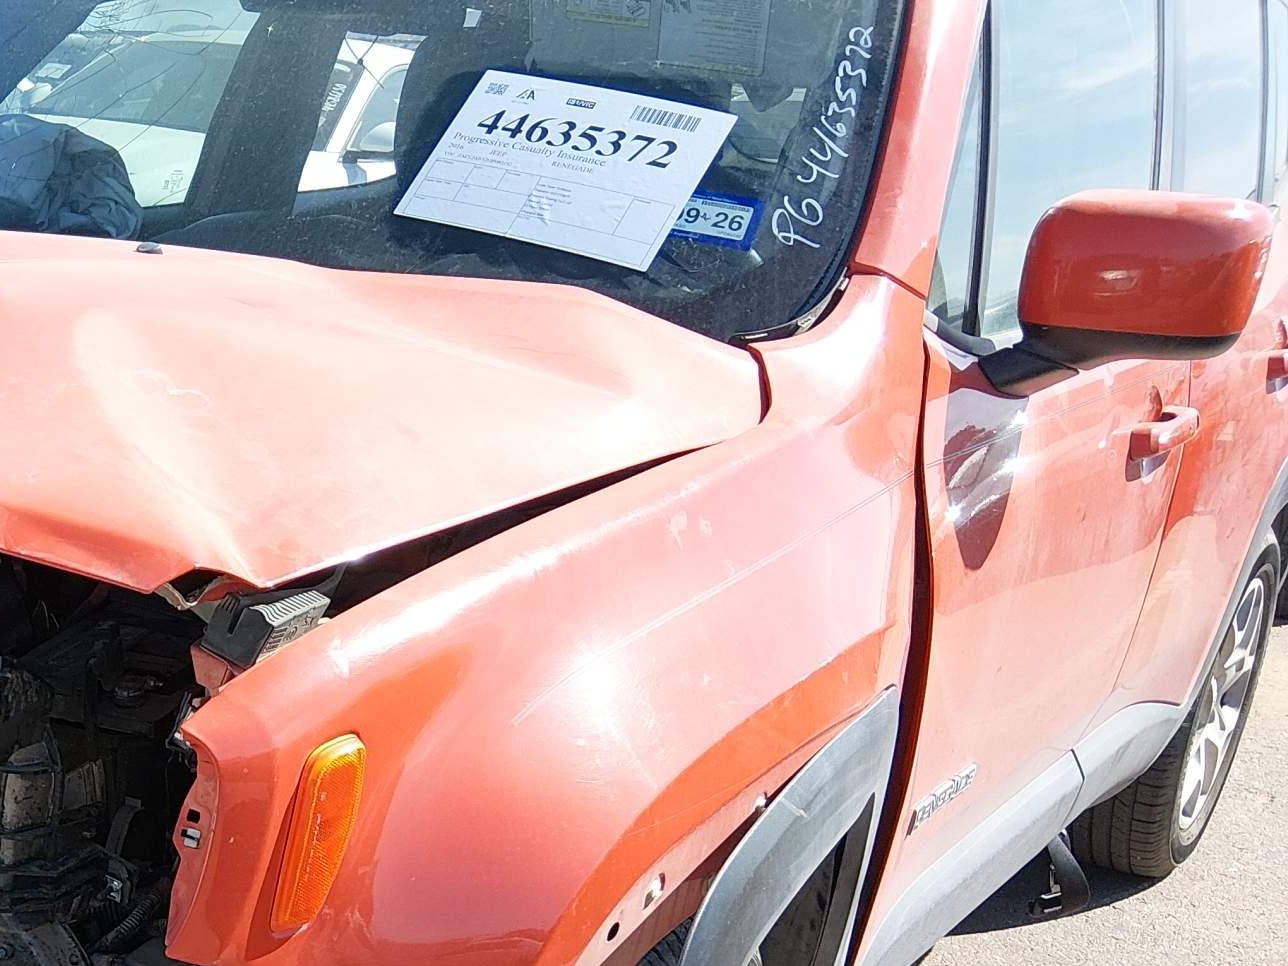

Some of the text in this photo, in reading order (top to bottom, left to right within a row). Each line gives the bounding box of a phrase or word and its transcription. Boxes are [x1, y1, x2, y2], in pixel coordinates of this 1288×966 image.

[796, 26, 874, 185] 44635372
[453, 131, 511, 150] Progressive
[511, 140, 556, 159] Casualty
[556, 149, 608, 168] Insurance
[477, 109, 678, 169] 44635372
[676, 206, 701, 225] 9
[711, 211, 746, 232] 26
